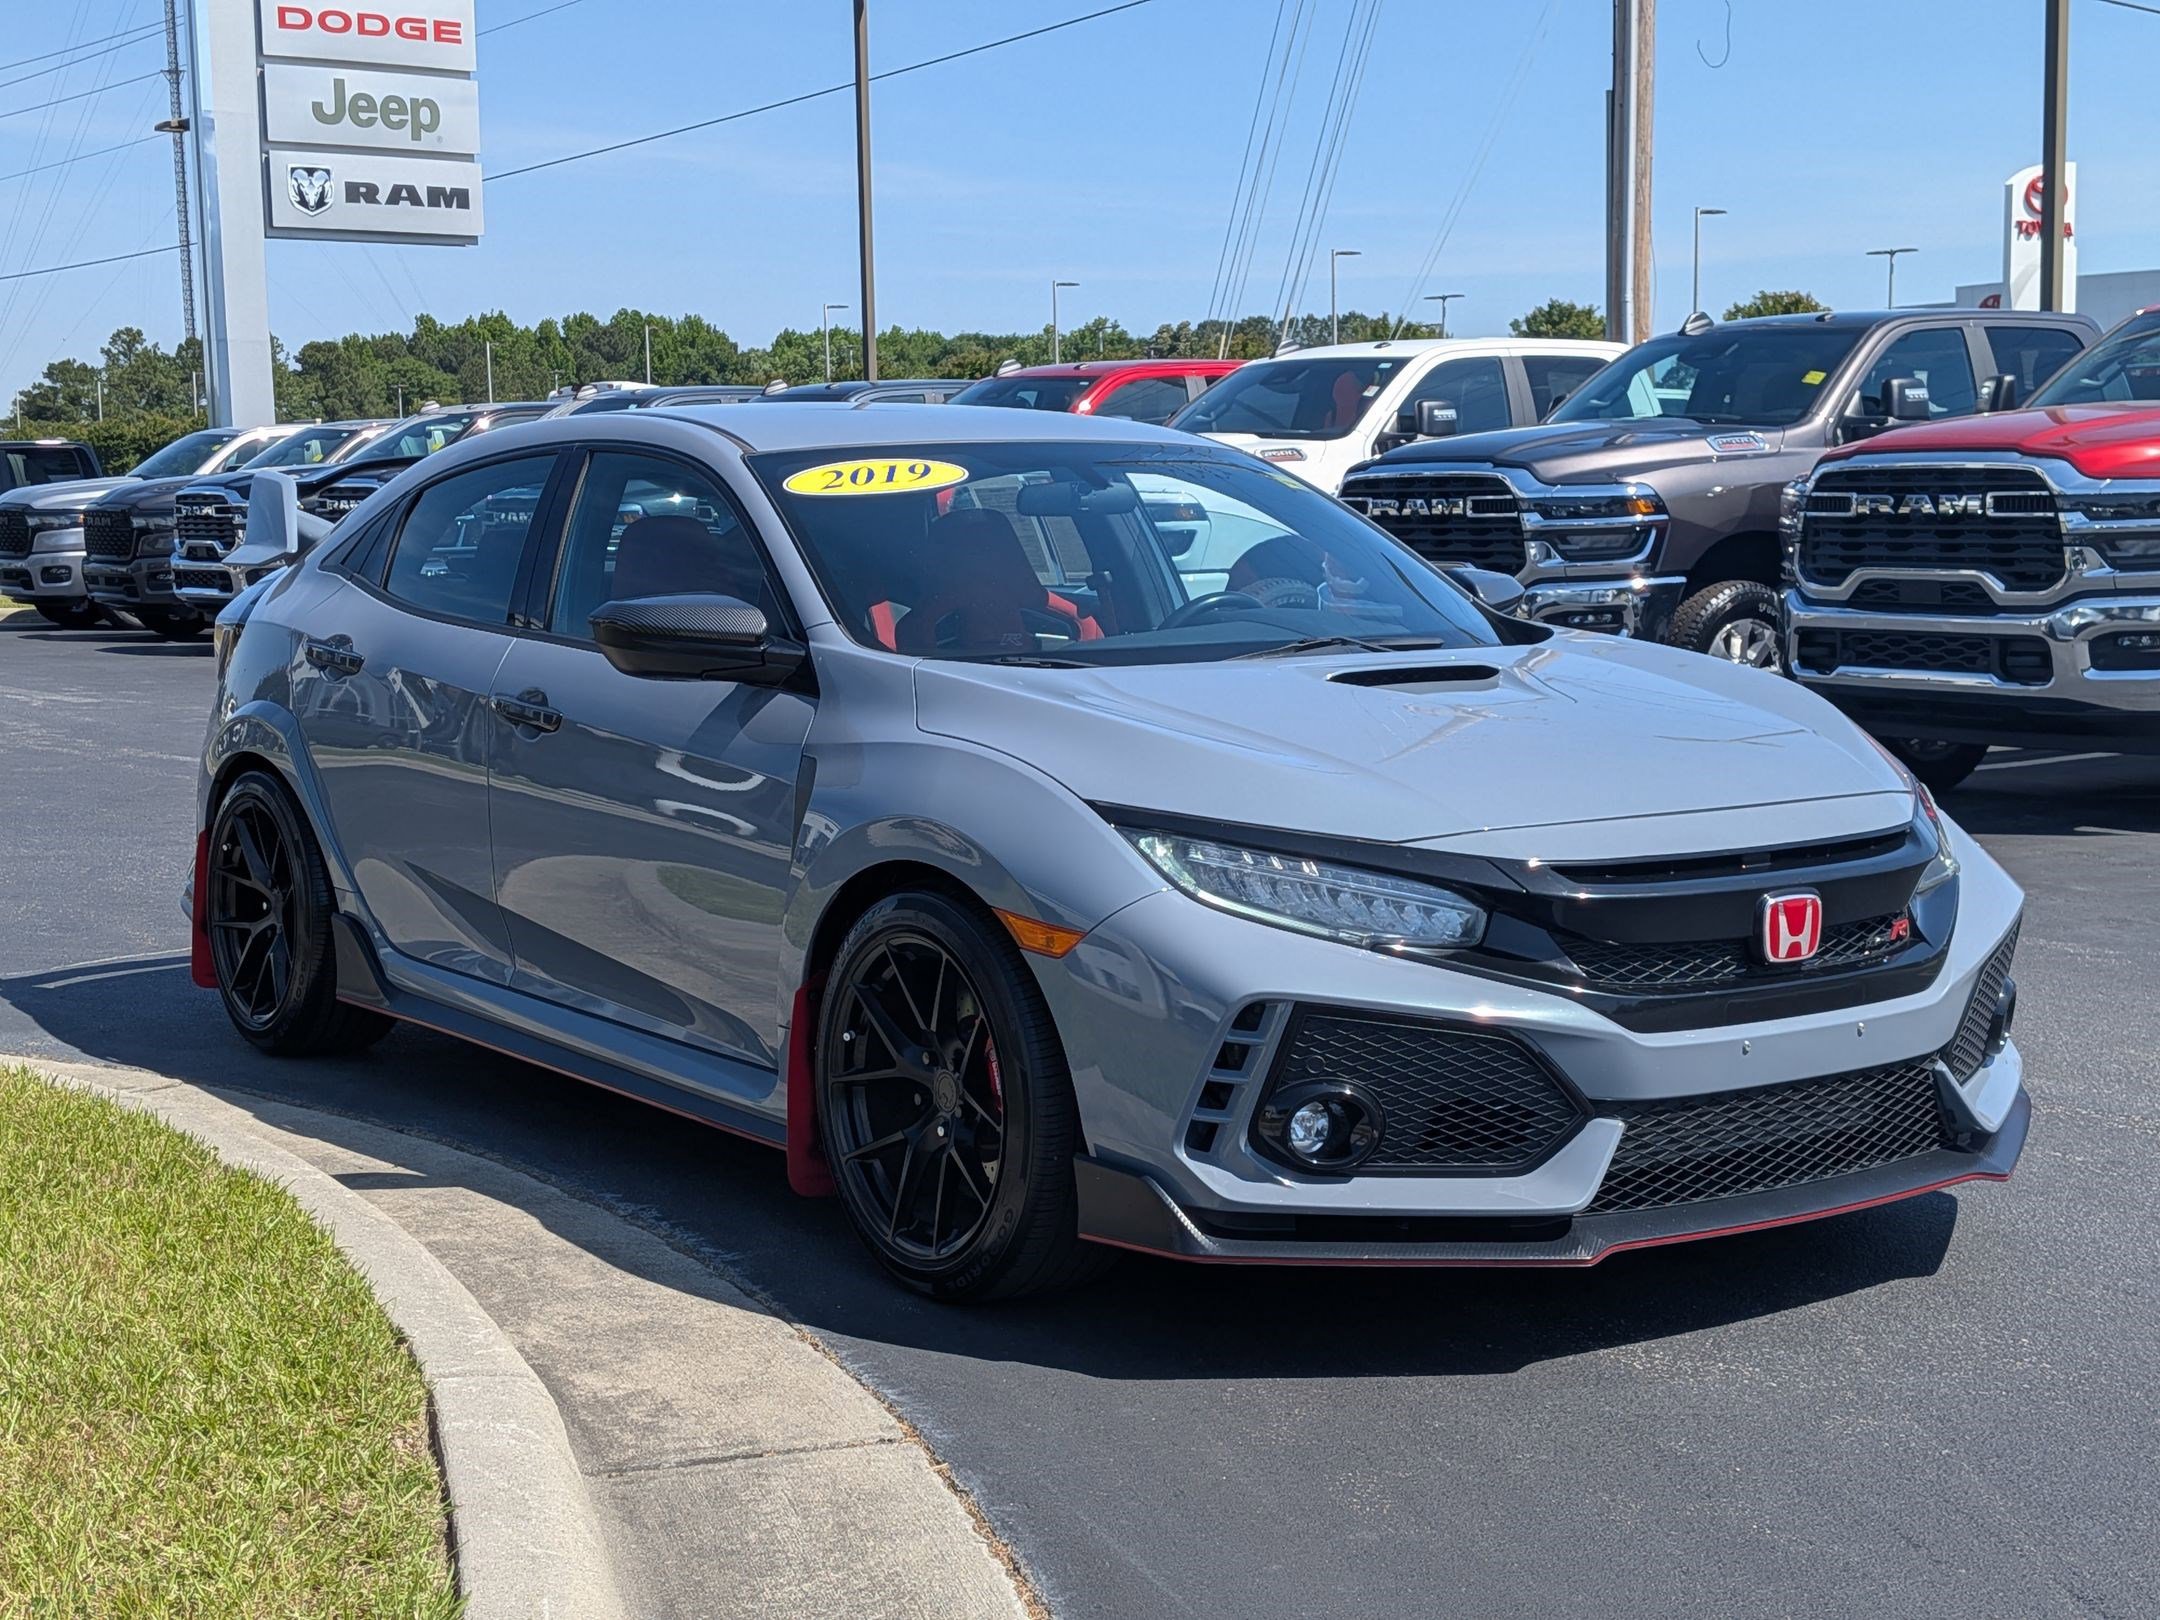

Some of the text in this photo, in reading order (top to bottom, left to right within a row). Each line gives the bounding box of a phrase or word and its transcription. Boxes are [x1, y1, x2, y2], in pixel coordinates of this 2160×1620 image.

[277, 6, 463, 45] DODGE
[312, 78, 441, 141] Jeep
[344, 181, 470, 210] RAM
[2015, 221, 2074, 237] TOYA
[820, 463, 932, 491] 2019
[1370, 498, 1464, 517] RAM
[1857, 493, 1983, 515] RAM
[85, 516, 111, 527] RAM
[1889, 918, 1910, 941] R
